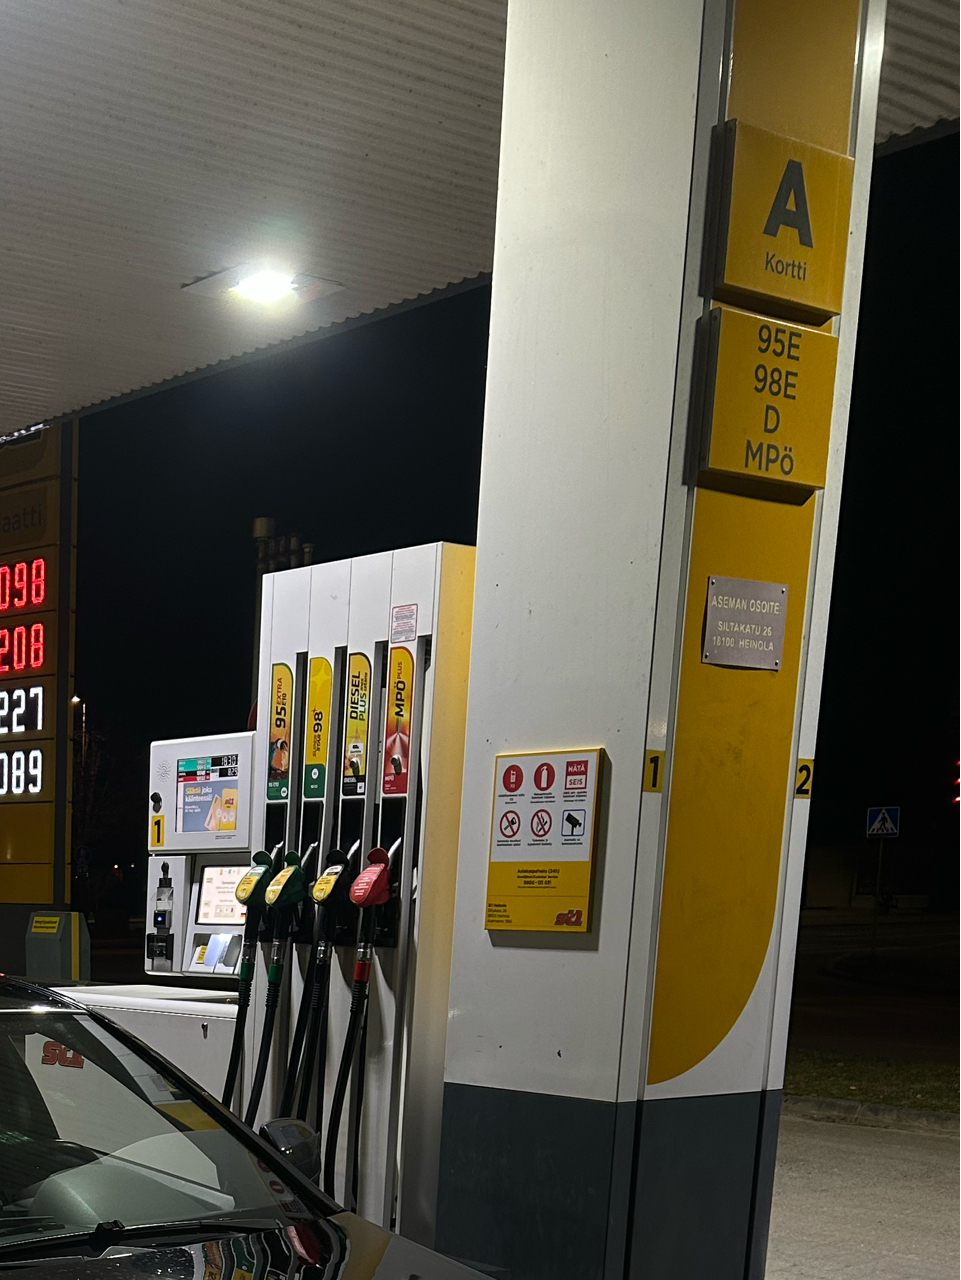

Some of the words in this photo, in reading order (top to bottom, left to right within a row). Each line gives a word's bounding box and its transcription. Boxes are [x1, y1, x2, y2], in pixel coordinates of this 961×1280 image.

[762, 159, 813, 248] A
[765, 251, 807, 281] Kortti
[757, 324, 803, 361] 95E
[754, 363, 797, 401] 98E
[764, 405, 780, 433] D
[744, 439, 794, 476] MPö
[711, 596, 747, 611] ASEMAN
[717, 621, 760, 635] SILTAKATU
[762, 626, 772, 636] 26
[713, 636, 734, 647] 18100
[739, 638, 774, 651] HEINOLA
[350, 671, 360, 720] DIESEL
[359, 692, 367, 721] PLUS
[394, 680, 406, 718] MPÖ
[275, 705, 287, 728] 95
[313, 711, 323, 733] 98
[568, 764, 585, 772] HÄTÄ
[569, 778, 583, 786] SEIS
[649, 756, 659, 788] 1
[796, 764, 812, 796] 2
[153, 819, 161, 843] 1
